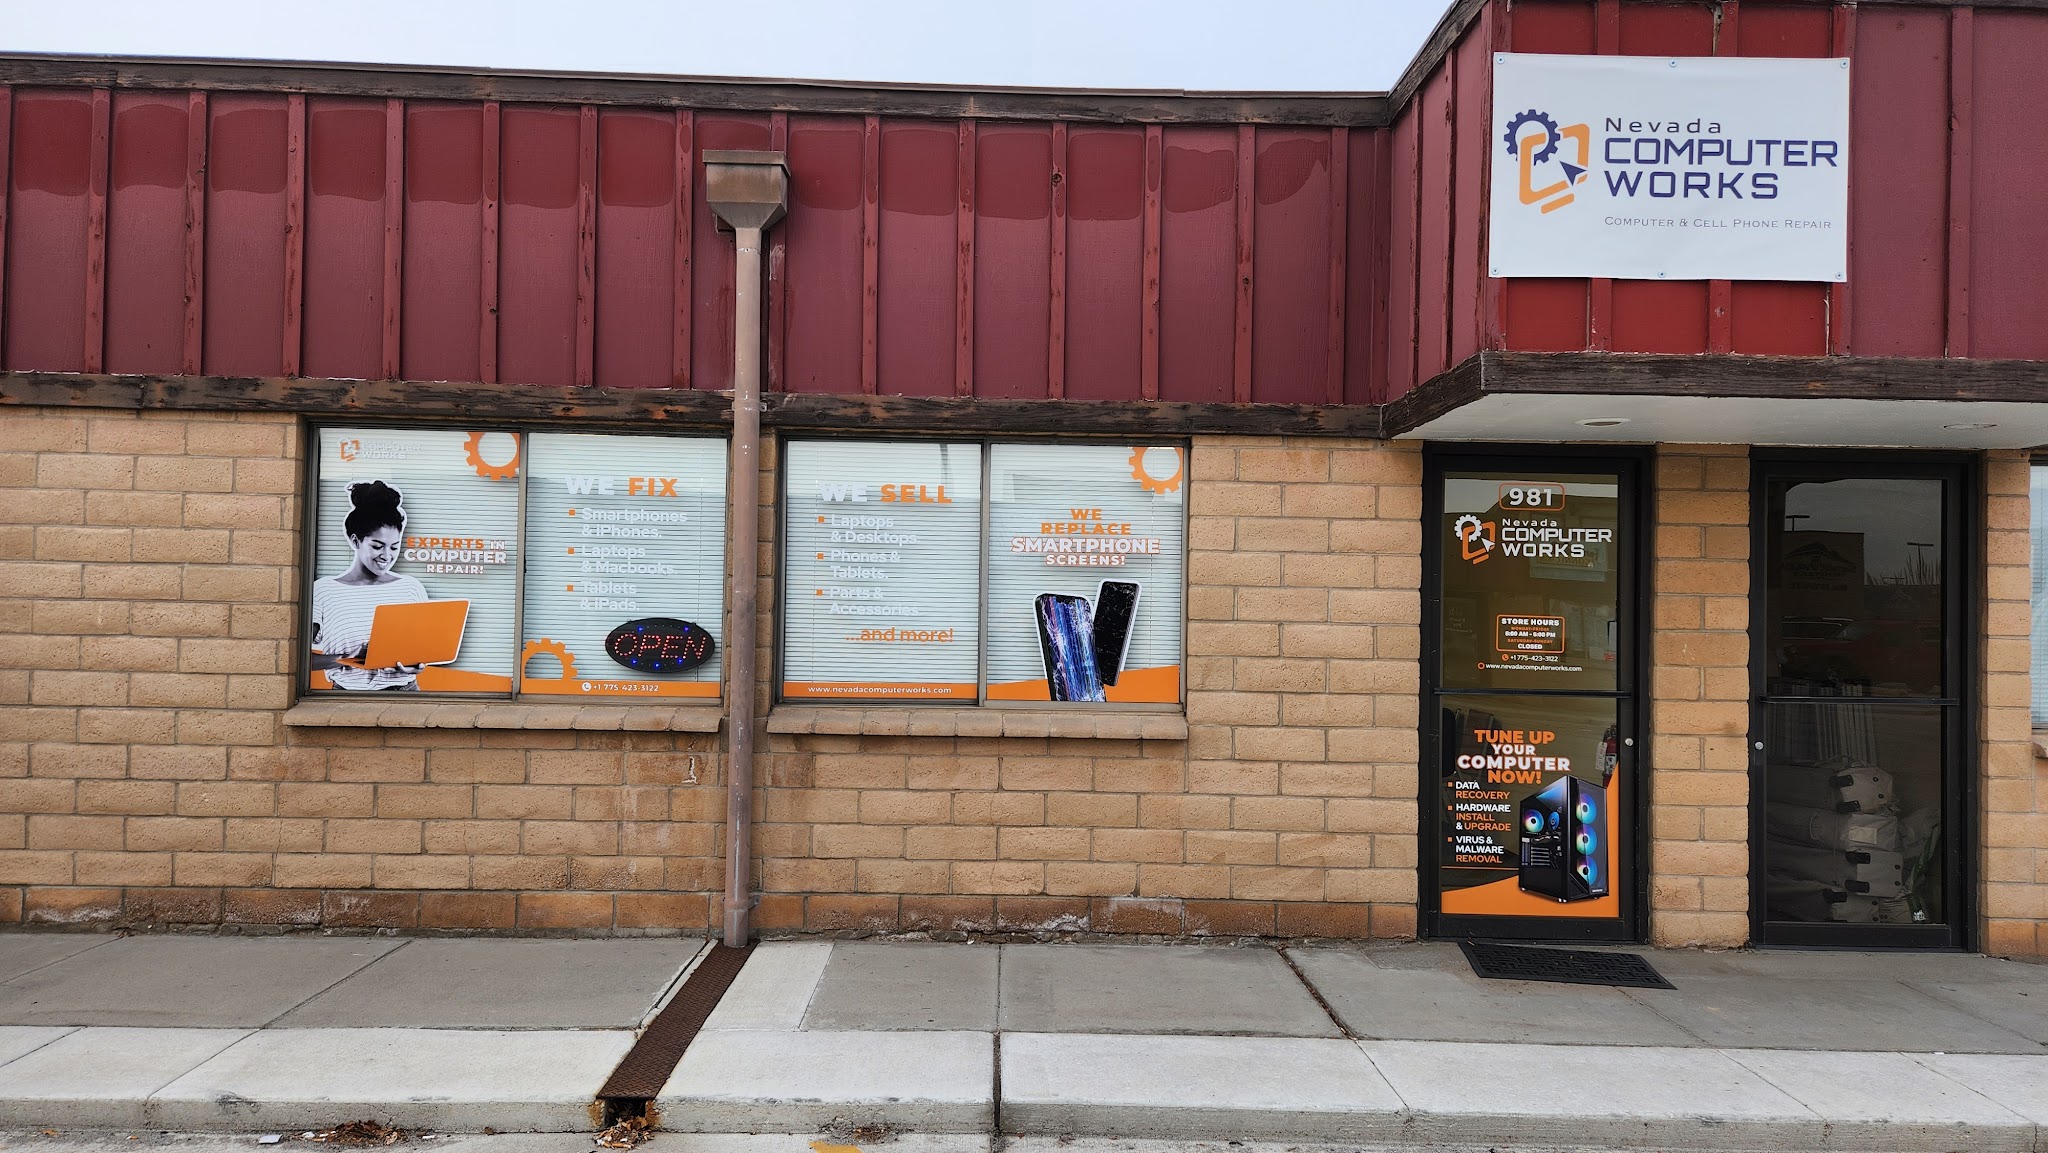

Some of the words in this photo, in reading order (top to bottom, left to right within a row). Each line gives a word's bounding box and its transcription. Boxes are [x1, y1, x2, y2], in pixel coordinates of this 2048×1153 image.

[1605, 117, 1721, 134] Nevada
[1604, 137, 1838, 167] COMPUTER
[1604, 170, 1779, 200] WORKS
[1679, 219, 1688, 228] &
[565, 475, 615, 495] WE
[628, 477, 678, 497] FIX
[821, 484, 868, 503] WE
[880, 484, 952, 504] SELL
[1508, 487, 1552, 506] 981
[582, 507, 688, 524] Smartphones
[1070, 508, 1103, 521] WE
[831, 514, 894, 530] Laptops
[1040, 522, 1132, 535] REPLACE
[1502, 518, 1558, 527] Nevada
[582, 524, 592, 537] &
[831, 530, 842, 543] &
[1501, 527, 1613, 543] COMPUTER
[407, 536, 485, 550] EXPERTS
[490, 539, 505, 550] IN
[1011, 536, 1161, 554] SMARTPHONE
[403, 548, 507, 564] COMPUTER
[582, 545, 645, 560] Laptops
[830, 550, 887, 562] Phones
[889, 551, 901, 562] &
[1501, 542, 1585, 558] WORKS
[1045, 554, 1126, 566] SCREENS!
[426, 563, 484, 574] REPAIR!
[581, 561, 592, 573] &
[581, 580, 638, 595] Tablets
[830, 586, 873, 599] Parts
[876, 587, 884, 599] &
[580, 598, 590, 610] &
[1501, 617, 1529, 625] STORE
[1530, 618, 1560, 626] HOURS
[899, 628, 954, 642] more!
[614, 633, 707, 660] OPEN
[1485, 663, 1583, 672] www.nevadacomputerworks.com
[808, 686, 952, 695] www.nevadacomputerworks.com
[1474, 730, 1524, 743] TUNE
[1529, 731, 1556, 744] UP
[1491, 744, 1536, 755] YOUR
[1457, 754, 1571, 771] COMPUTER
[1487, 770, 1543, 785] NOW!
[1455, 781, 1481, 790] DATA
[1455, 791, 1511, 800] RECOVERY
[1455, 803, 1512, 813] HARDWARE
[1455, 812, 1496, 822] INSTALL
[1455, 822, 1463, 831] &
[1464, 822, 1512, 832] UPGRADE
[1455, 836, 1485, 845] VIRUS
[1486, 836, 1493, 845] &
[1455, 845, 1505, 855] MALWARE
[1455, 855, 1503, 864] REMOVAL
